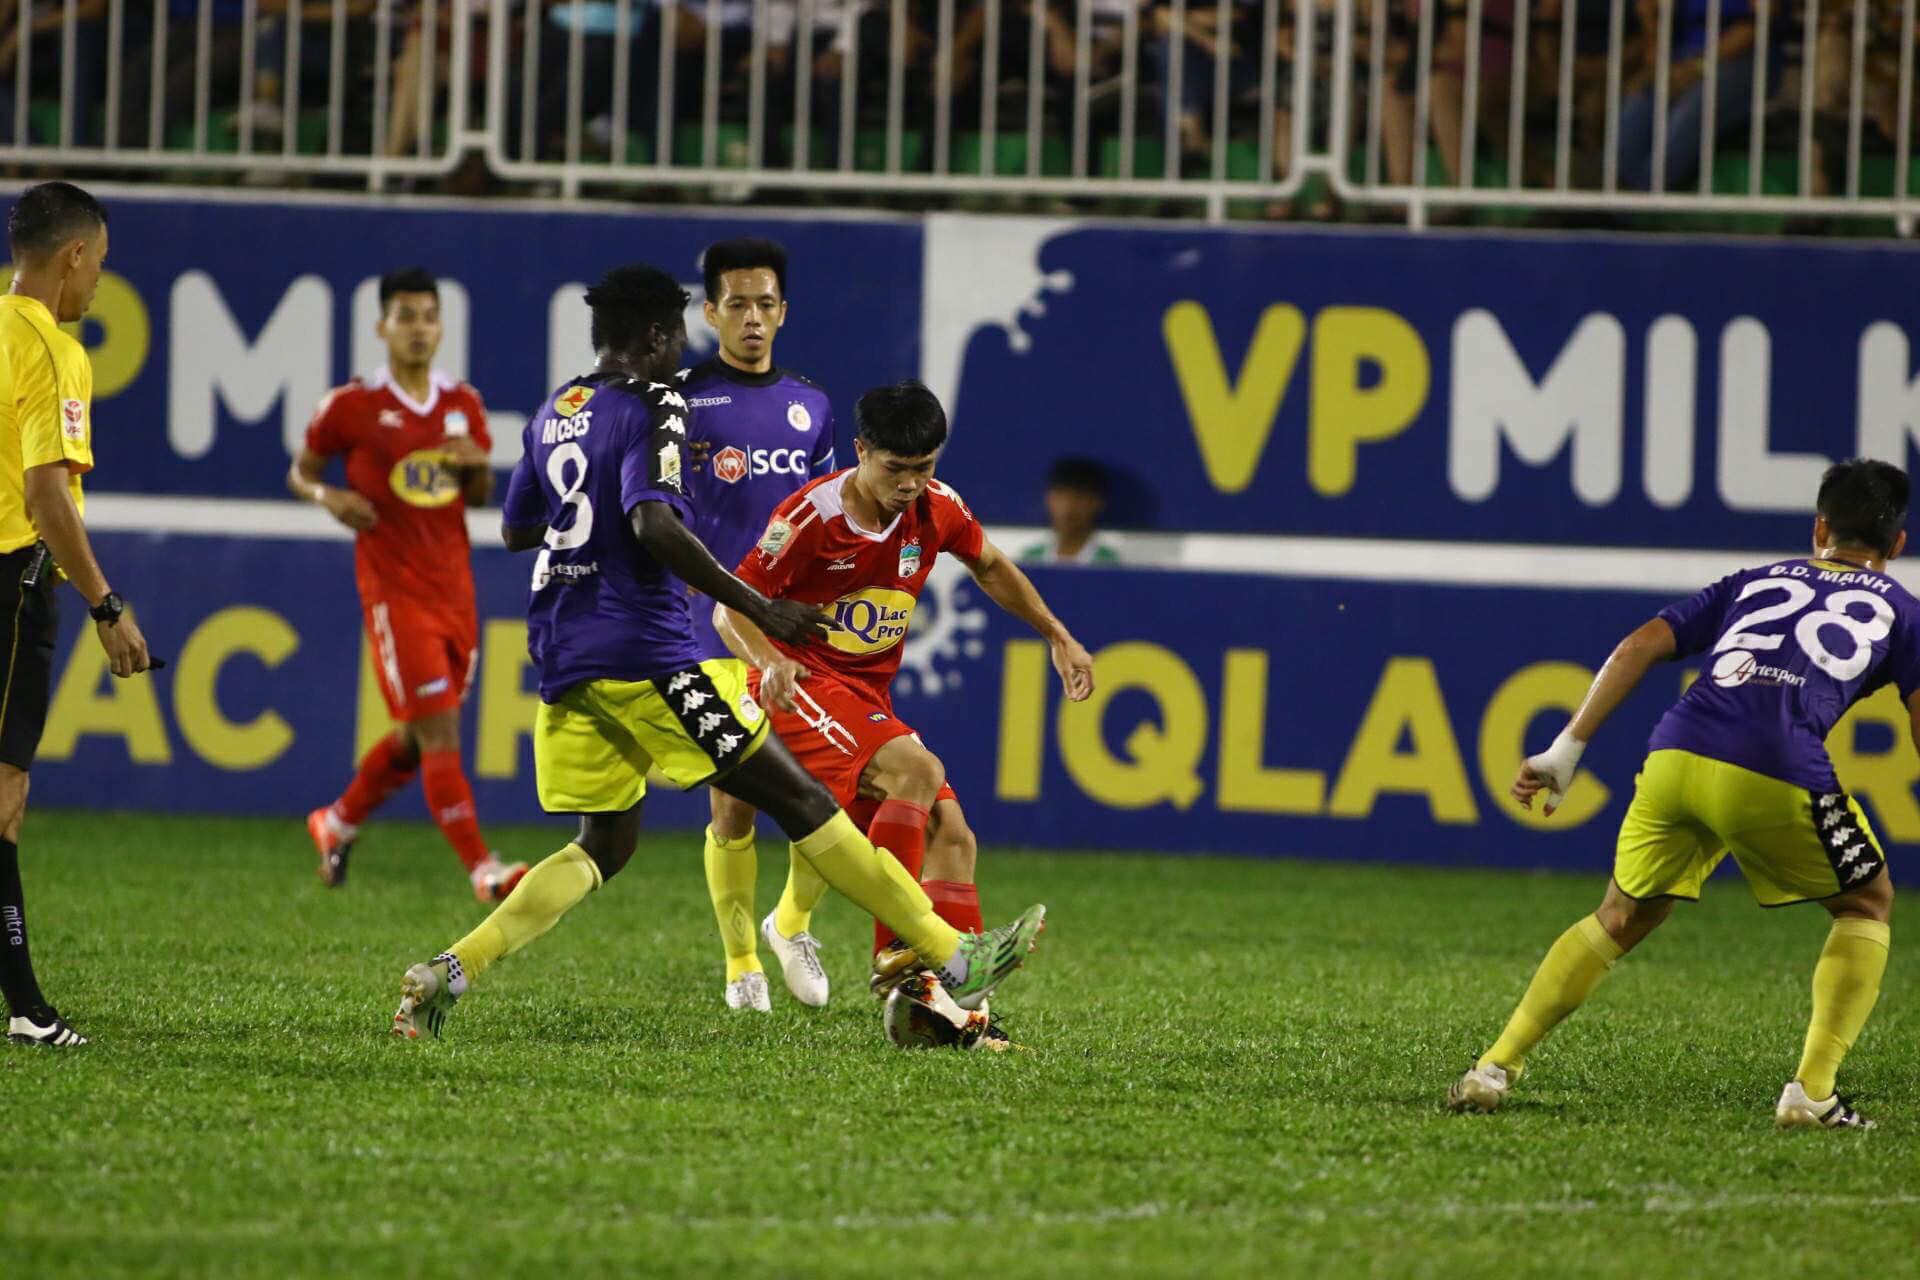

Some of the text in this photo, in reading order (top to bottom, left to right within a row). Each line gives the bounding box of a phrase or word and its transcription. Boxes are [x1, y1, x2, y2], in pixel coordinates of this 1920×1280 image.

[541, 410, 593, 445] MOSES
[752, 449, 806, 475] SCG
[544, 442, 593, 550] 8
[828, 600, 880, 644] IQ
[877, 625, 904, 639] Pro
[879, 606, 908, 621] Lac
[1711, 577, 1896, 682] 28
[995, 638, 1611, 832] IQLAC
[2, 904, 24, 946] mitre
